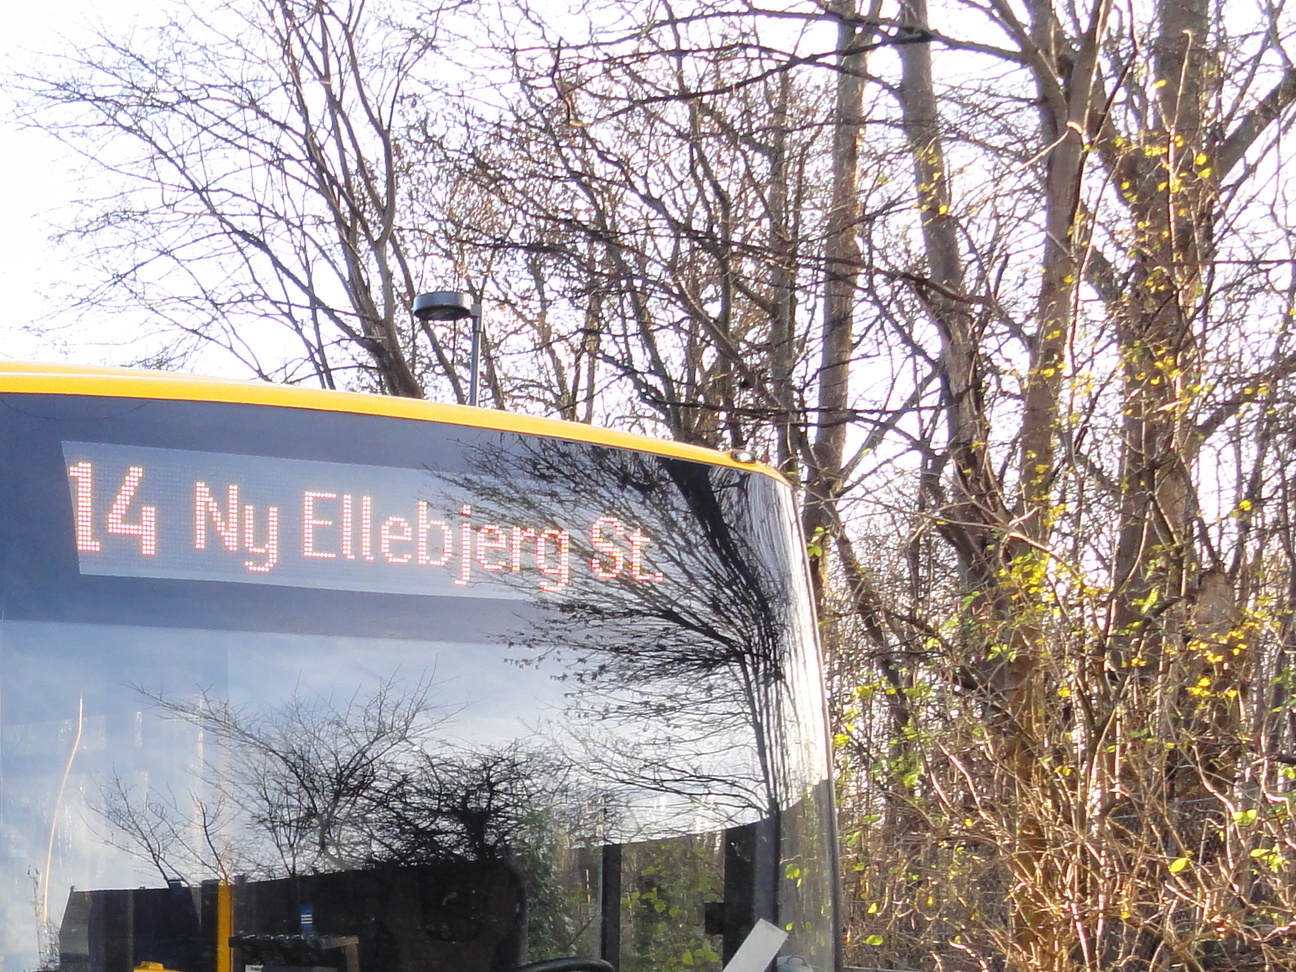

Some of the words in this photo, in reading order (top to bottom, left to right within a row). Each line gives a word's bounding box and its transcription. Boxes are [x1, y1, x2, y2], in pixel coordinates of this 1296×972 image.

[68, 461, 157, 557] 14
[194, 481, 279, 574] Ny
[303, 491, 571, 593] Ellebjerg
[591, 516, 665, 583] St.
